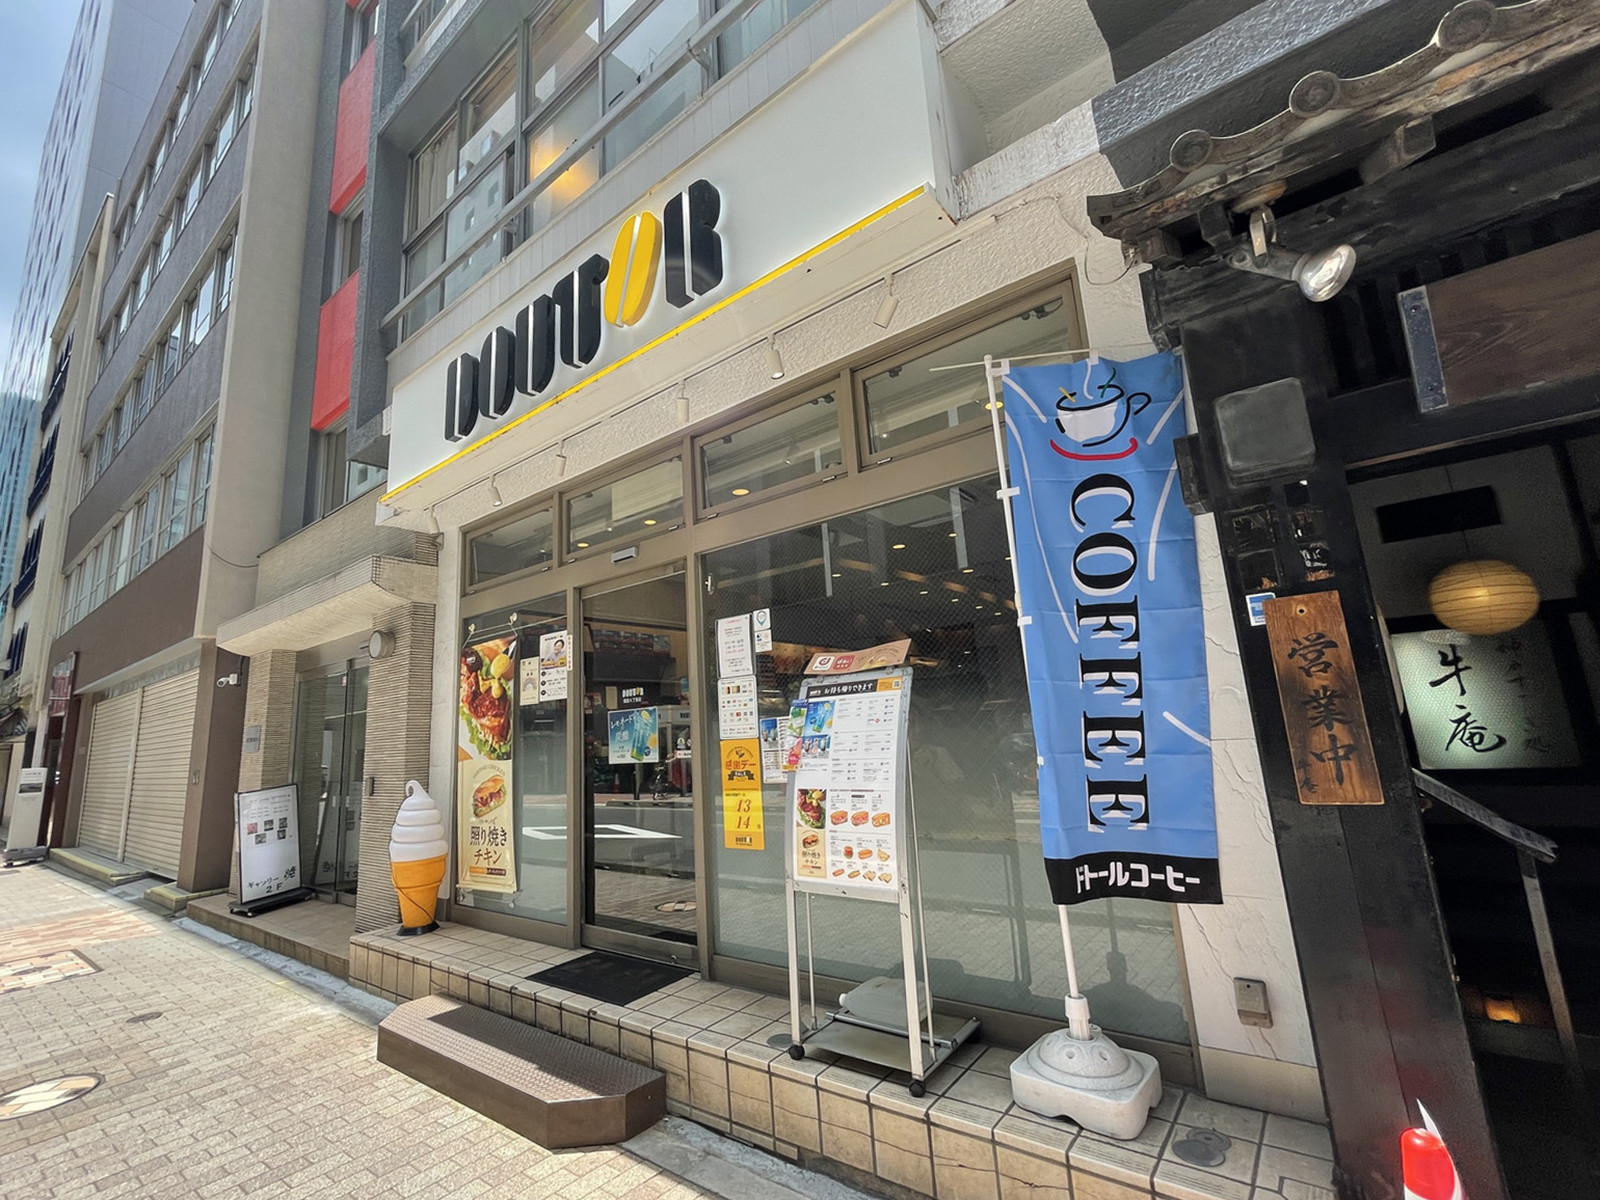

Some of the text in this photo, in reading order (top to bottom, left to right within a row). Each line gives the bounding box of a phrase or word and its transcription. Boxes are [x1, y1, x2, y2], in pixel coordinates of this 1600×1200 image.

[444, 178, 724, 443] DOUTOR
[1069, 472, 1151, 834] COFFEE
[1288, 632, 1360, 786] 営業中
[1429, 644, 1507, 753] 牛庵
[736, 815, 751, 829] 14
[737, 799, 752, 813] 13
[470, 825, 508, 847] 照り焼き
[473, 847, 503, 866] チキン
[1075, 861, 1201, 894] ドトールコーヒー
